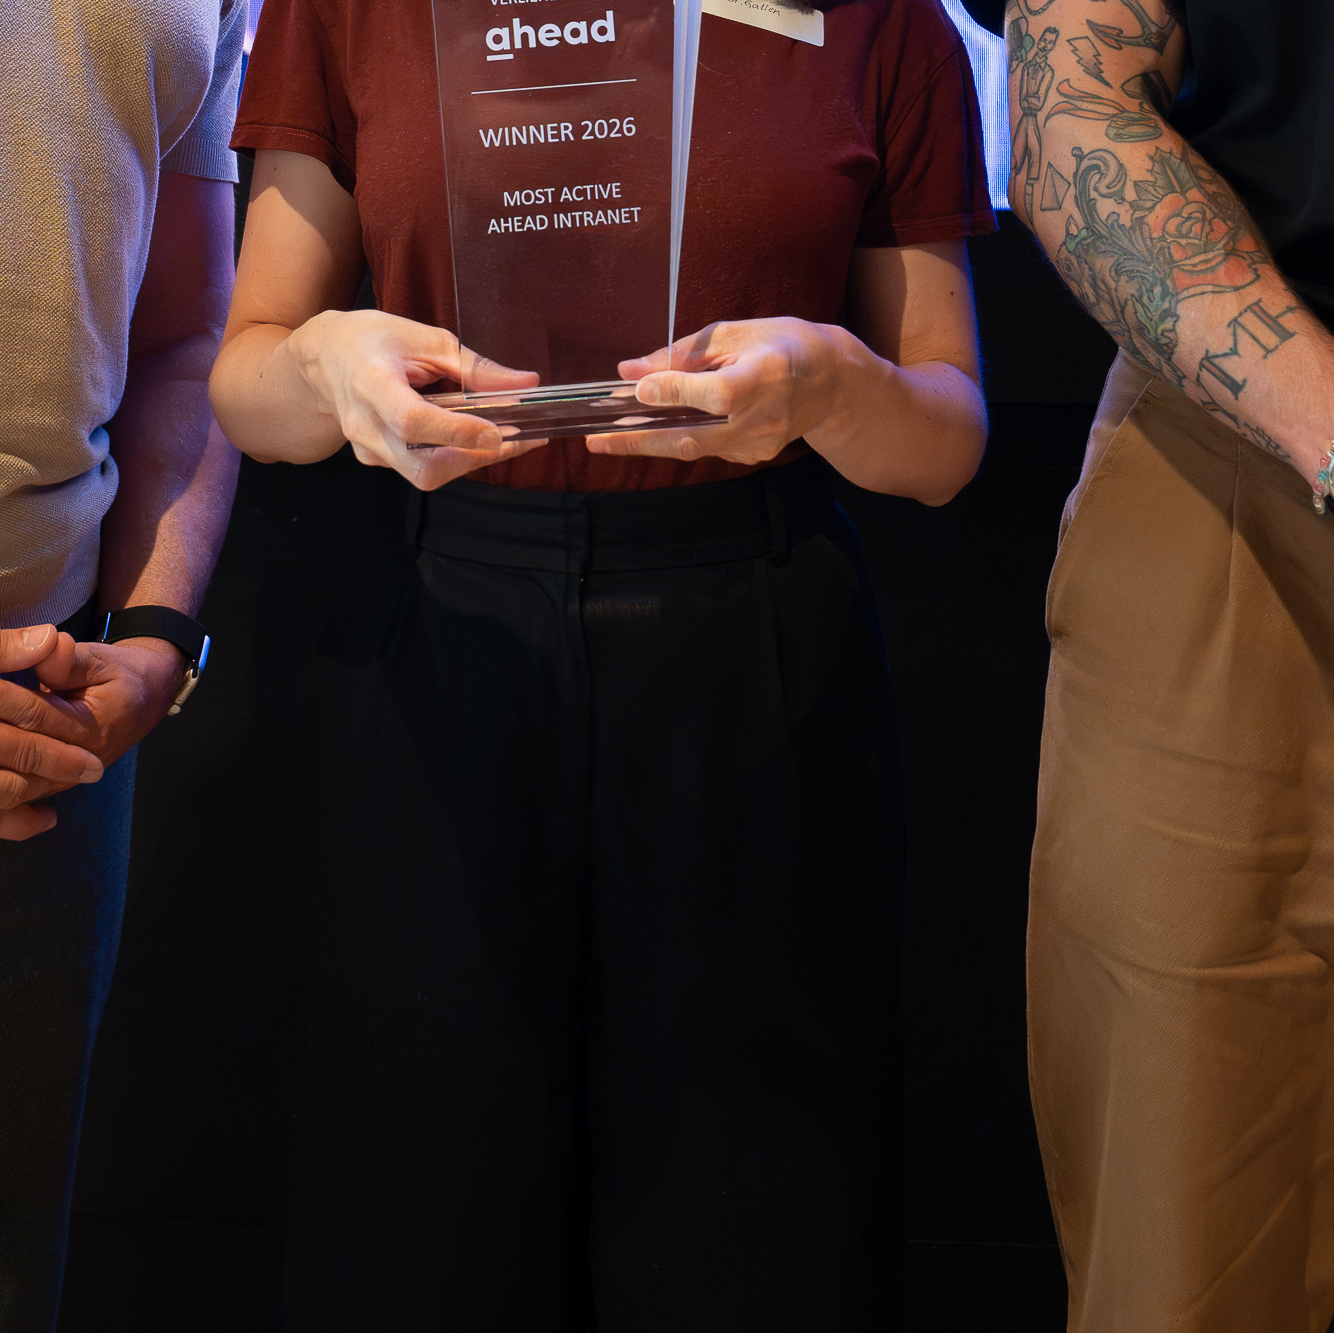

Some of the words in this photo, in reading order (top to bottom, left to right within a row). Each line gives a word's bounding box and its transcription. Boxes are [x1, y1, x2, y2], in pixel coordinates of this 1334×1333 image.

[485, 10, 617, 61] ahead
[478, 122, 575, 148] WINNER
[580, 117, 637, 142] 2026
[502, 187, 556, 207] MOST
[560, 182, 623, 202] ACTIVE
[487, 215, 549, 234] AHEAD
[554, 207, 642, 229] INTRANET
